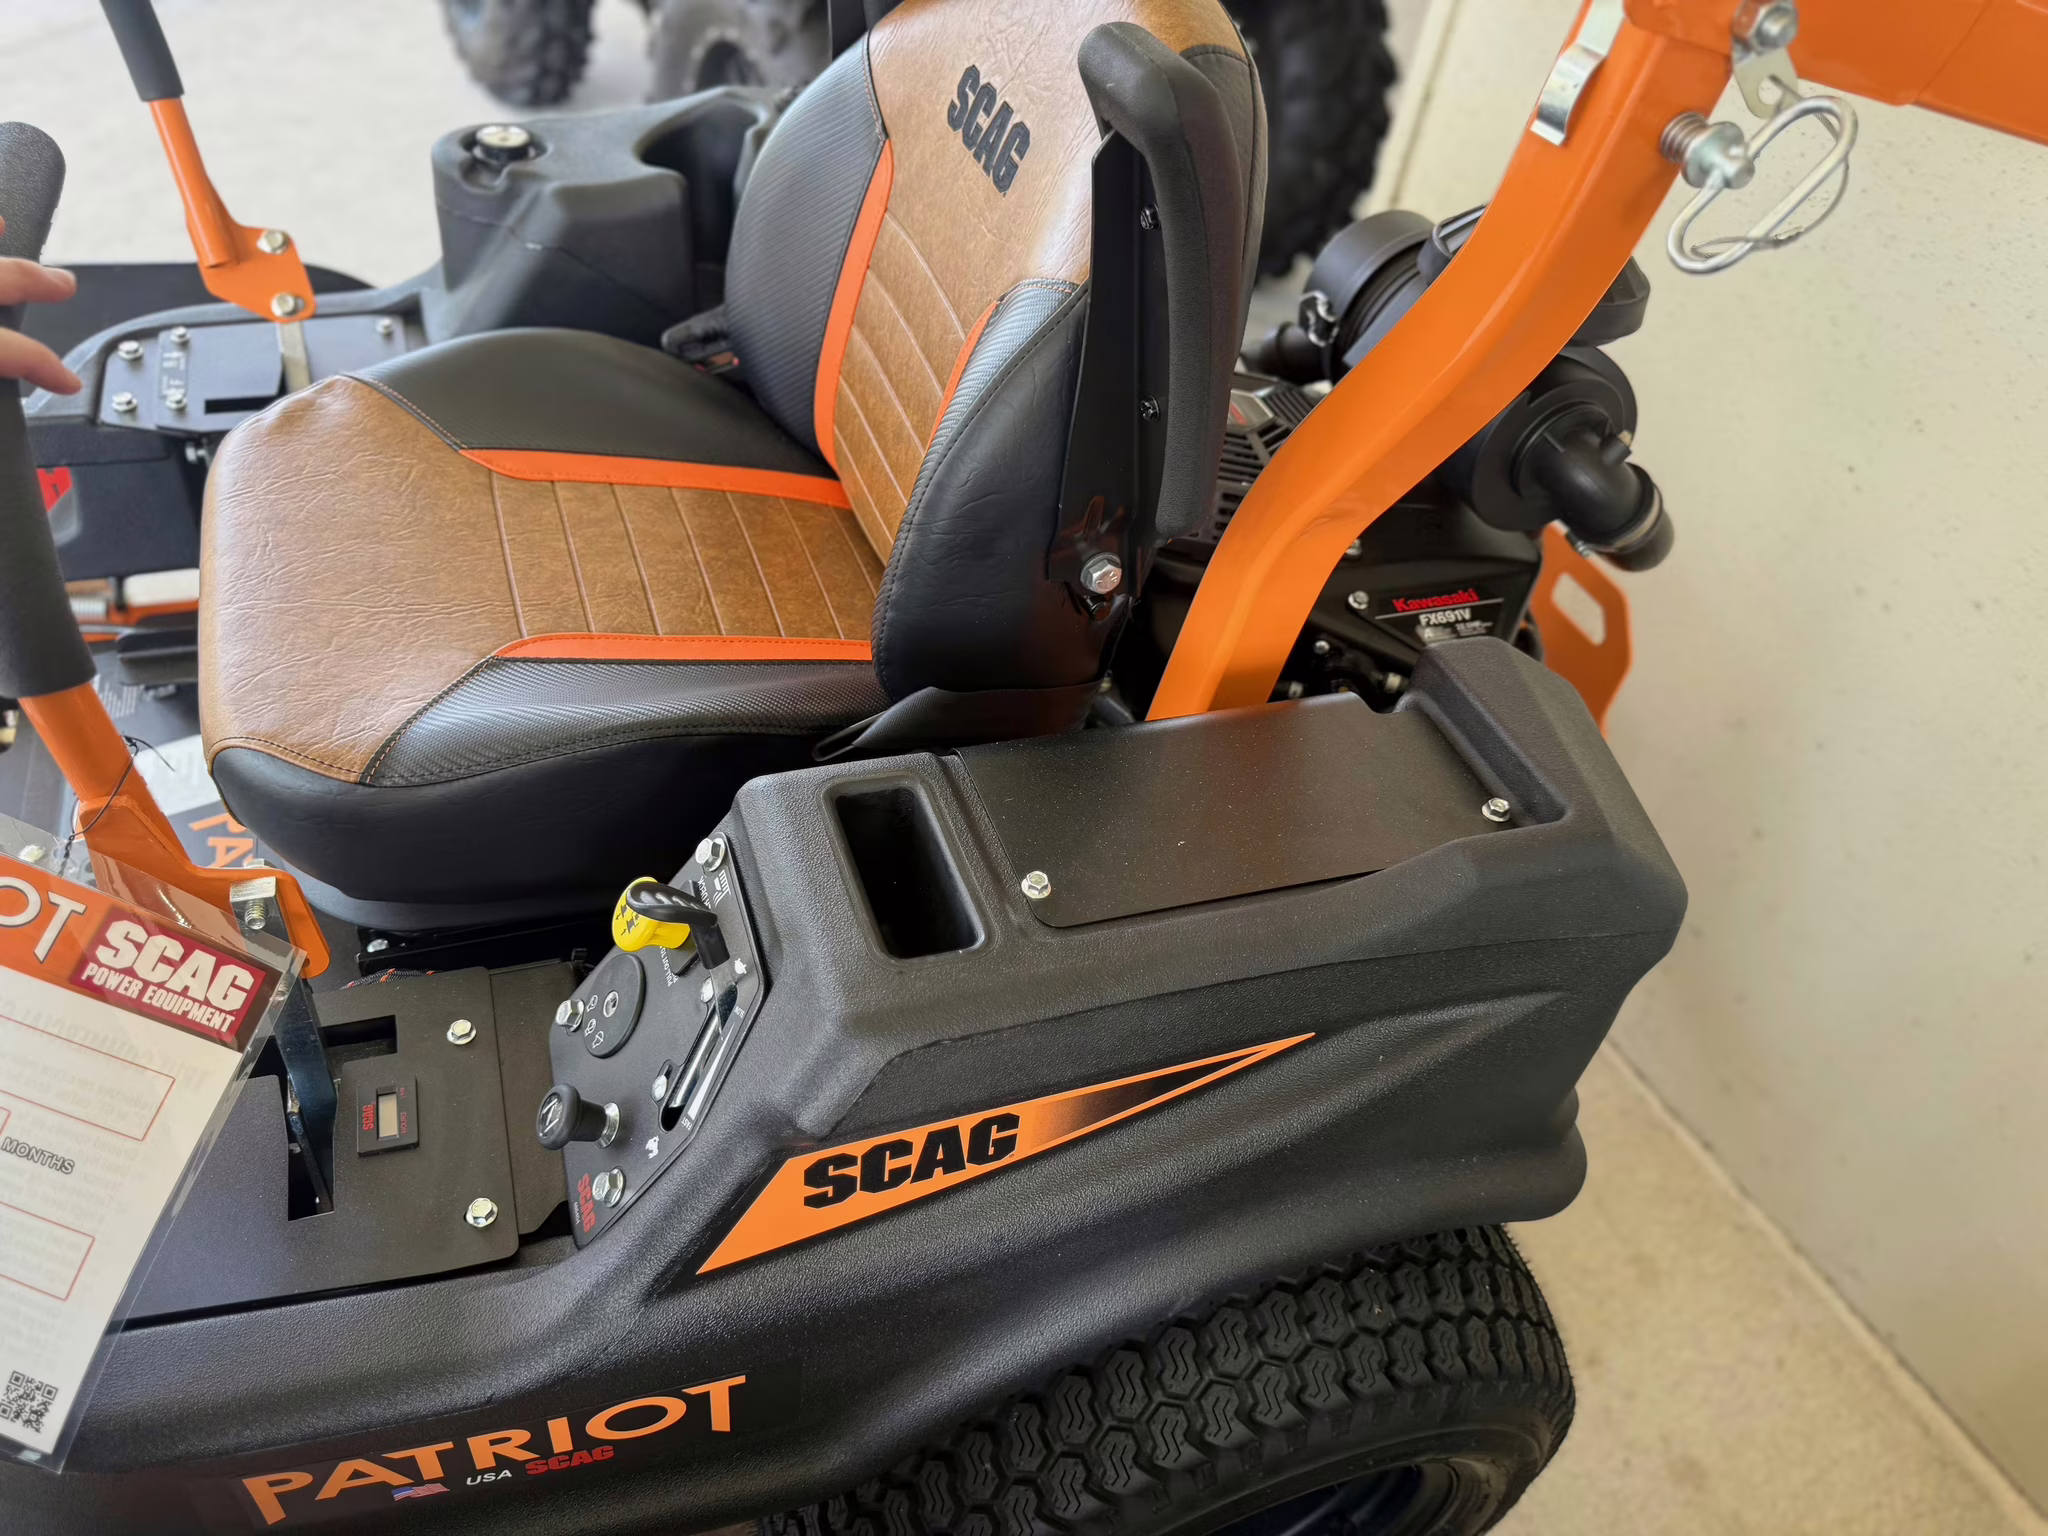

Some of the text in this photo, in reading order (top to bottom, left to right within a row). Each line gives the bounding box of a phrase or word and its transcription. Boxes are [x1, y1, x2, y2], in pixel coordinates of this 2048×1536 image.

[947, 64, 1031, 194] SCAG
[1392, 588, 1480, 613] Kawasaki
[1418, 608, 1473, 627] FX691V
[696, 876, 709, 902] DECK
[95, 920, 255, 1012] SCAG
[81, 962, 236, 1034] POWER EQUIPMENT
[362, 1103, 375, 1131] SCAG
[681, 1116, 693, 1131] FAST
[1, 1136, 76, 1175] MONTHS
[803, 1112, 1021, 1210] SCAG
[576, 1172, 598, 1233] SCAG
[242, 1374, 747, 1526] PATRIOT
[524, 1445, 615, 1476] SCAG
[466, 1469, 513, 1486] USA
